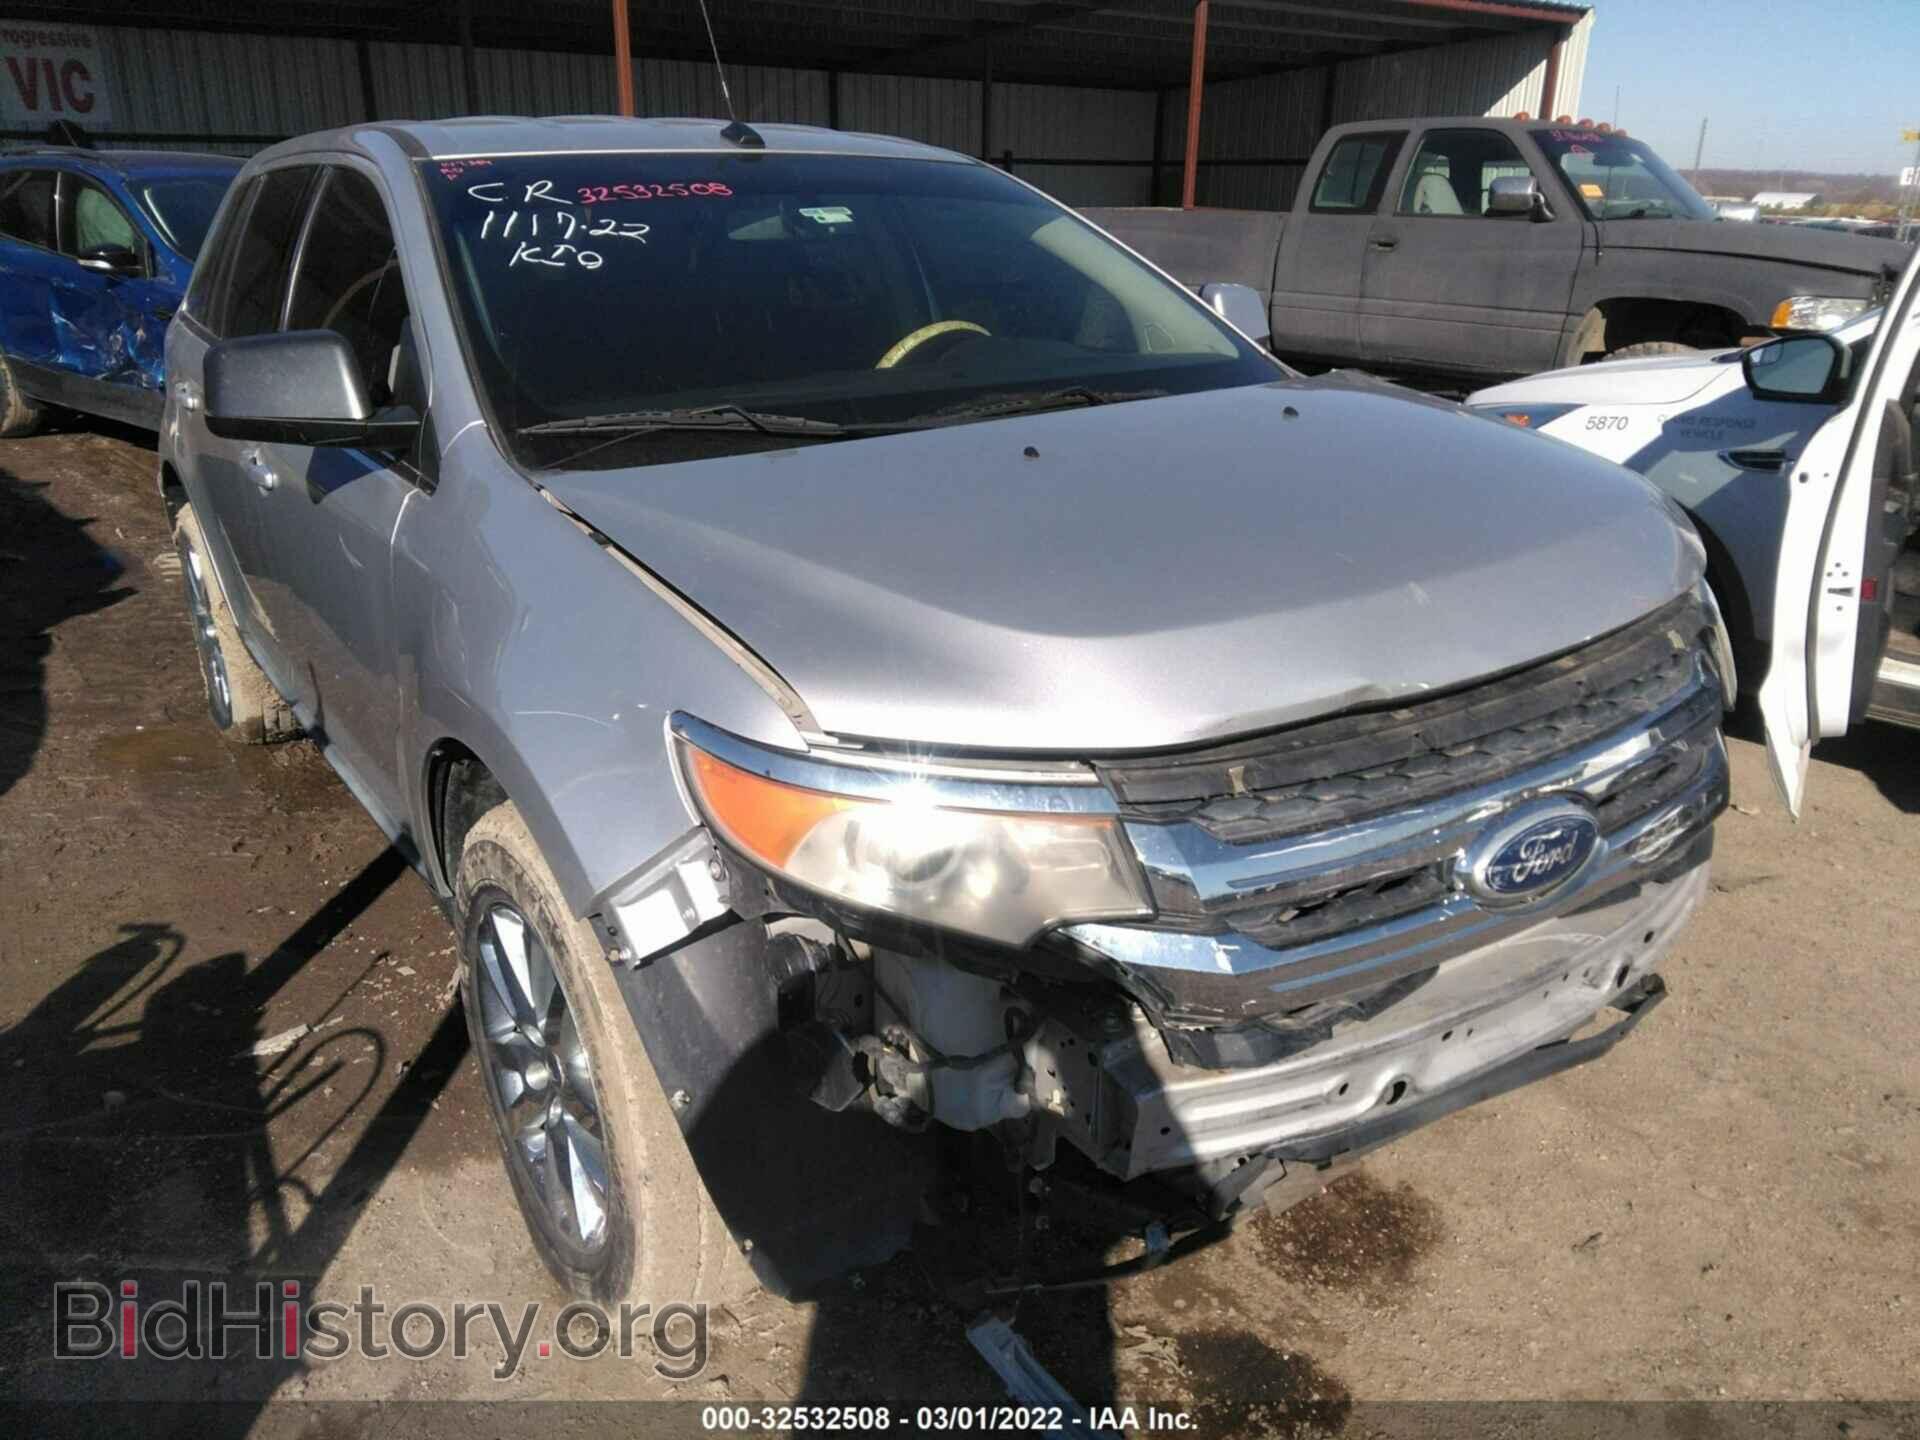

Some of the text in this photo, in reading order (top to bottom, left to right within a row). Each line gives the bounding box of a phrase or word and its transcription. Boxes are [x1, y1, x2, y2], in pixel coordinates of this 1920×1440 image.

[577, 182, 733, 204] 32532508
[1585, 415, 1629, 431] 5870
[1511, 828, 1579, 883] Ford
